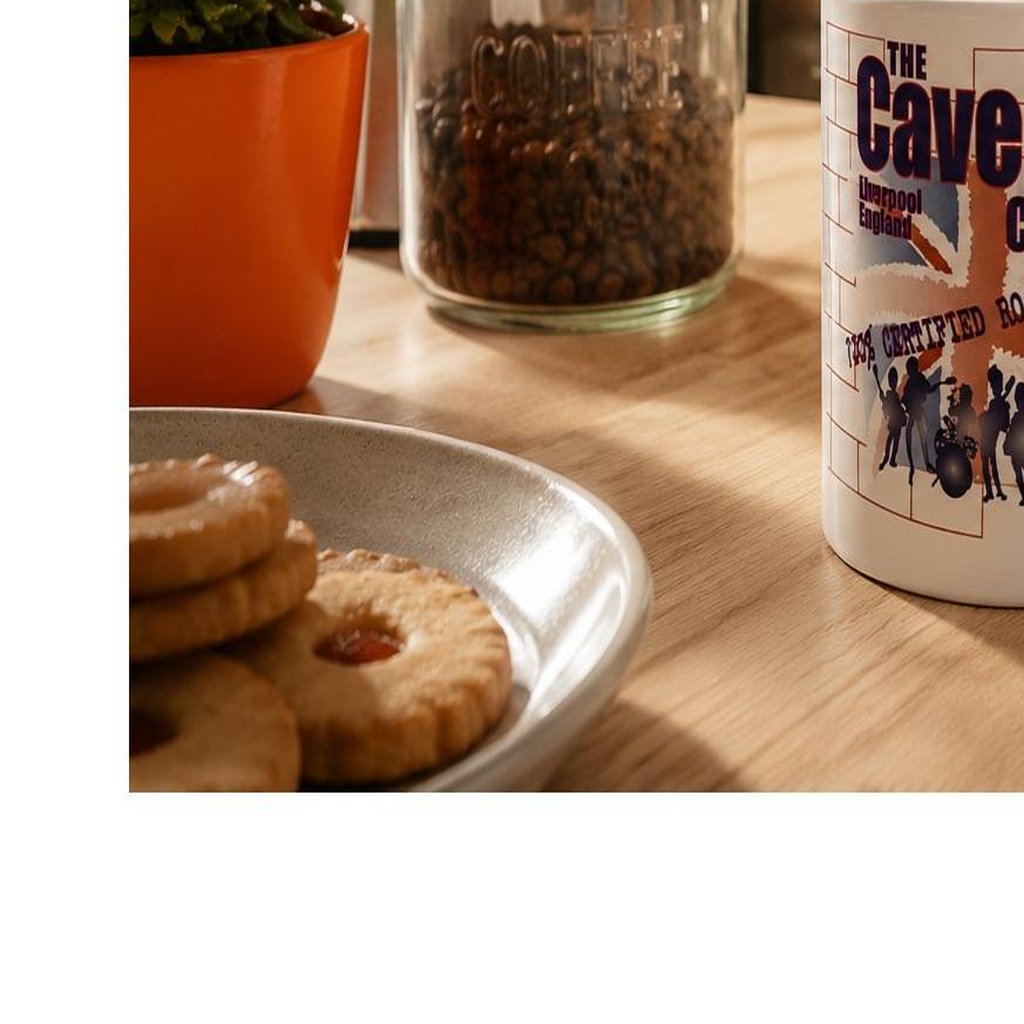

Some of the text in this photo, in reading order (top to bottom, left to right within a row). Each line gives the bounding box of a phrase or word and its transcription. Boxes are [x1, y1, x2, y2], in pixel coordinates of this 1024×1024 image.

[886, 41, 928, 81] THE
[859, 175, 922, 215] Liverpool
[859, 201, 912, 240] England
[881, 305, 986, 359] CERTIFIED
